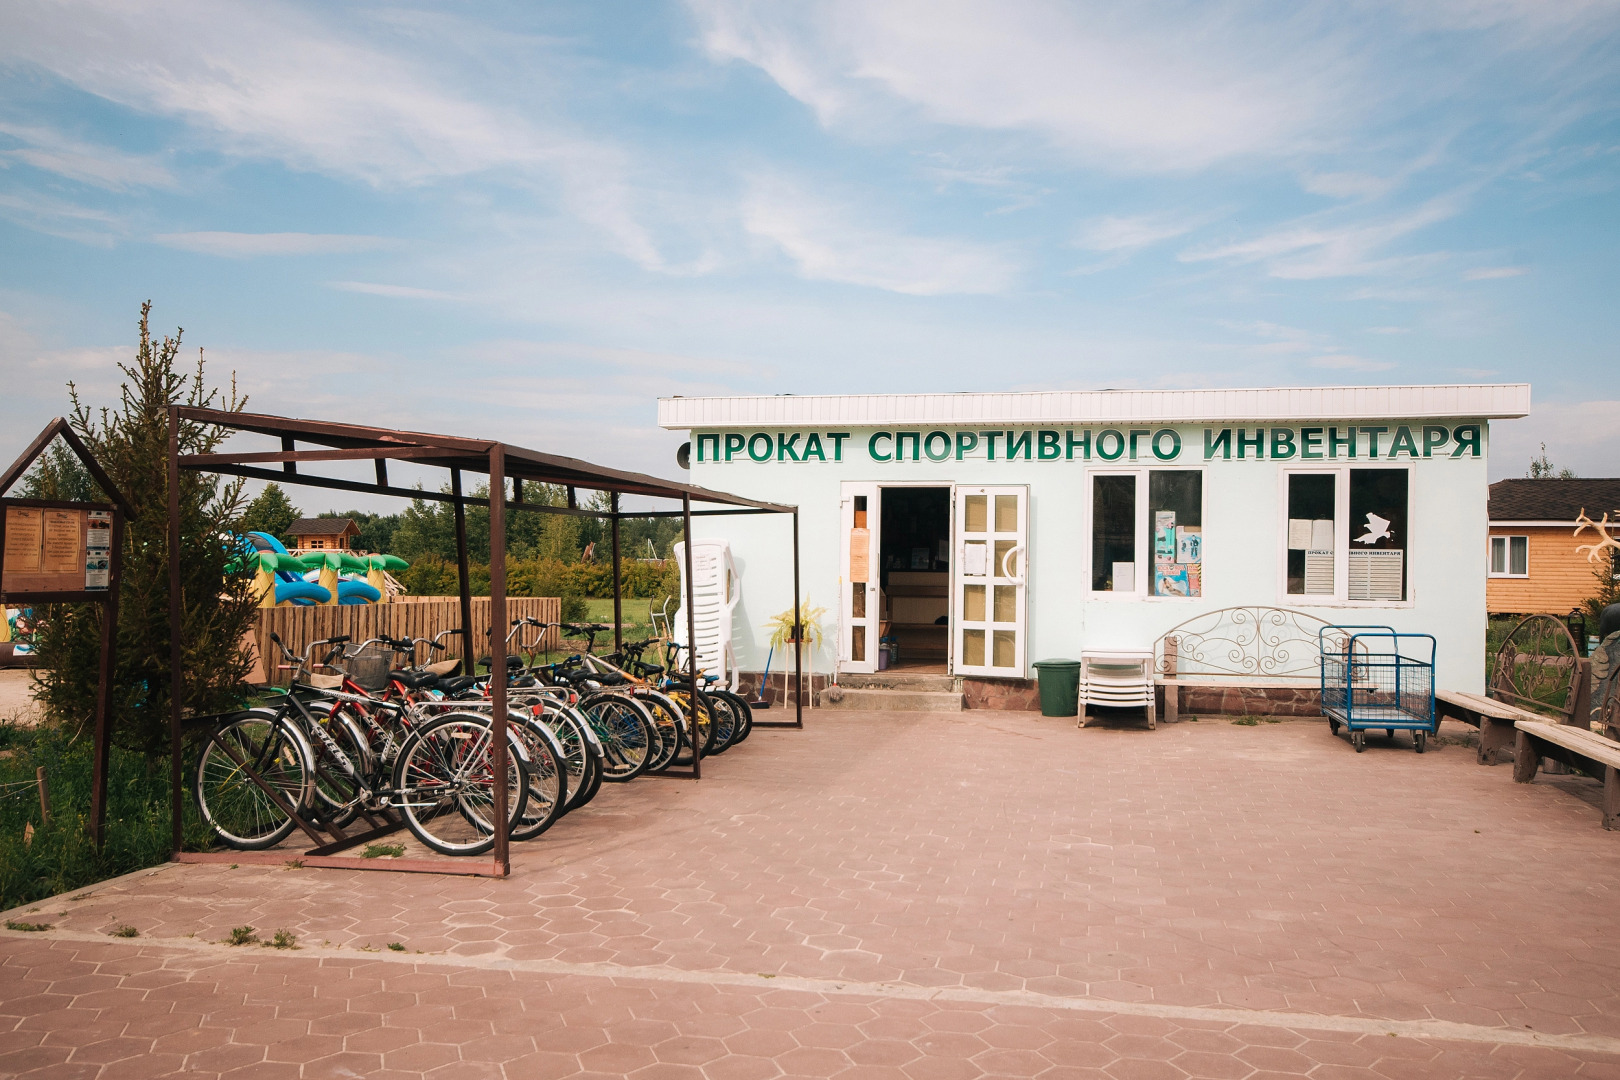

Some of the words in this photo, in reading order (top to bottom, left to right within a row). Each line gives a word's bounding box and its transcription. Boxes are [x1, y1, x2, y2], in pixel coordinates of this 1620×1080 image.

[696, 431, 851, 463] ПРОКАТ
[868, 428, 1183, 463] СПОРТИВНОГО
[1203, 424, 1483, 462] ИНВЕНТАРЯ
[315, 725, 350, 767] STELS
